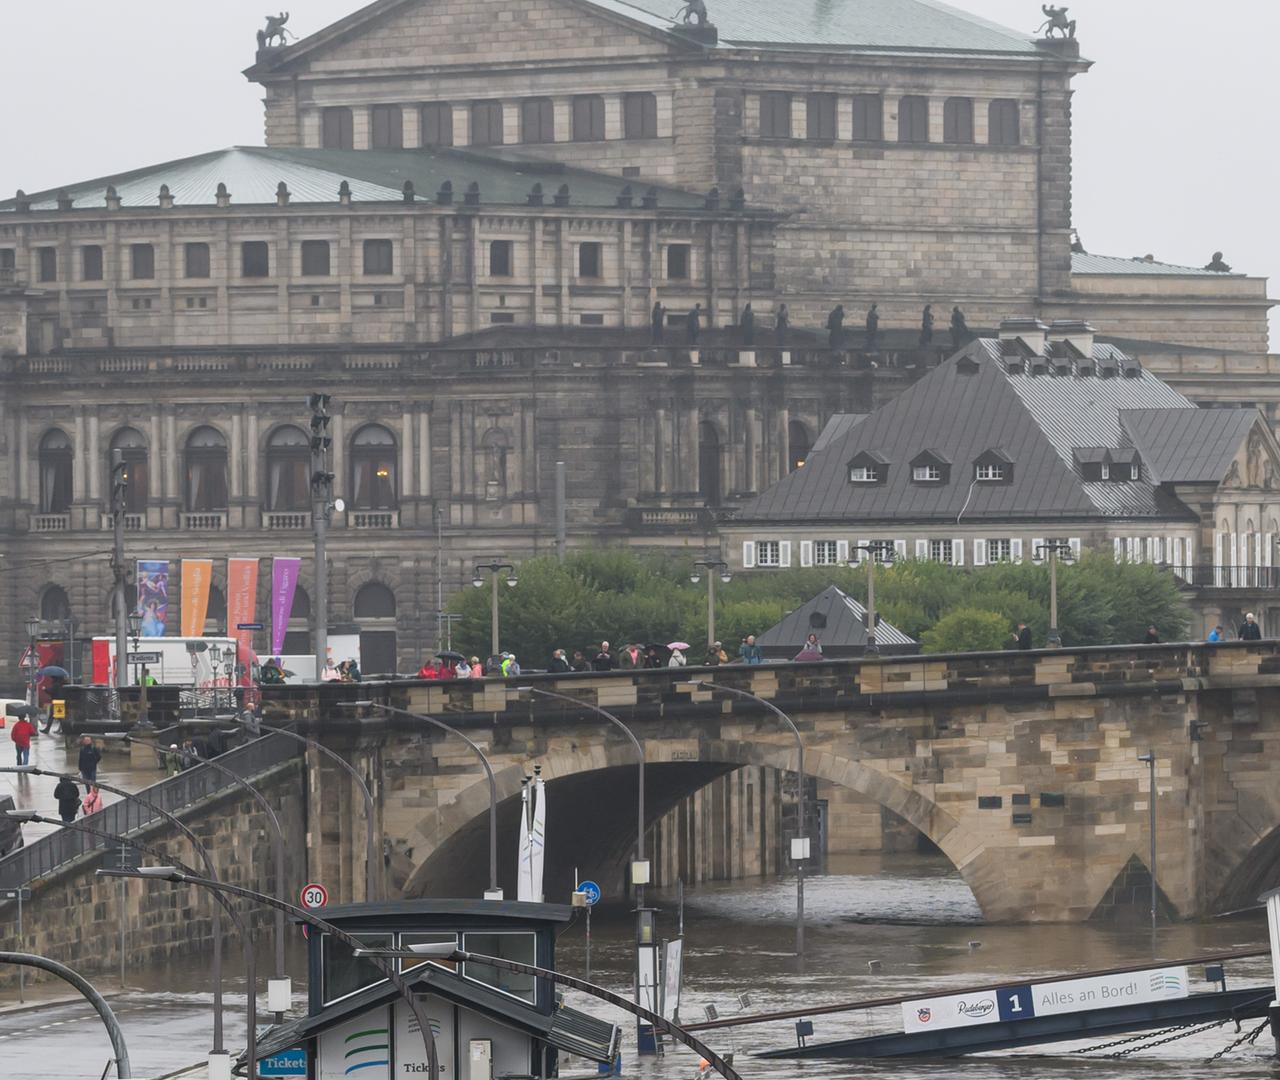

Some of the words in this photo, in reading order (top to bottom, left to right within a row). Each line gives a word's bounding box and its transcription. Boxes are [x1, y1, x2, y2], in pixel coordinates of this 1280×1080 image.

[307, 891, 322, 903] 30
[1008, 994, 1023, 1013] 1
[1041, 990, 1074, 1007] Alles
[1079, 989, 1096, 1001] an
[1101, 983, 1138, 999] Bord!
[958, 998, 995, 1017] Radeberger
[403, 1062, 446, 1072] Ticks
